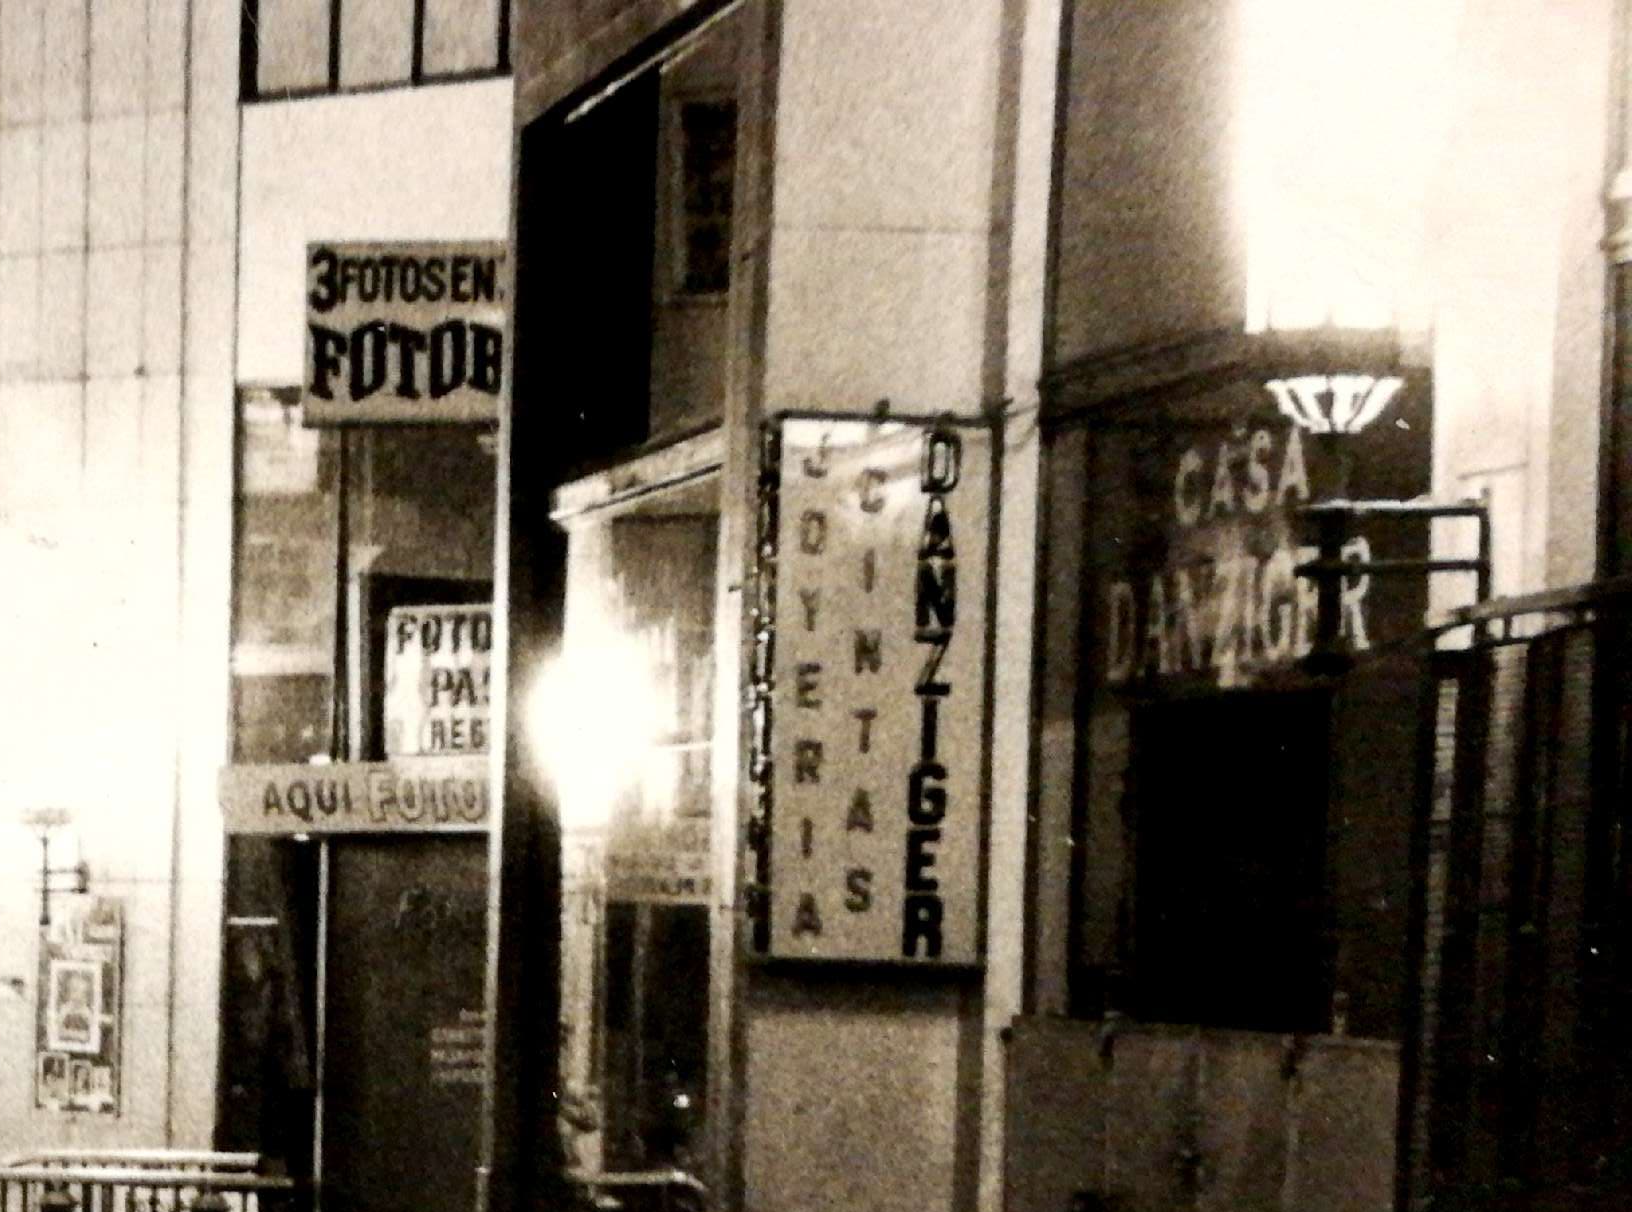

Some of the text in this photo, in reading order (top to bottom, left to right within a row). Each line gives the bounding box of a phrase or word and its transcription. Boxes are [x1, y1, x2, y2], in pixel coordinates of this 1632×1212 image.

[309, 245, 338, 313] 3
[340, 256, 446, 303] FOTOS
[451, 256, 495, 303] EN
[309, 318, 503, 402] FOTOB
[1174, 423, 1310, 526] CASA
[396, 613, 492, 655] FOTO
[1106, 536, 1371, 684] DANZIGER
[430, 666, 490, 707] PA
[791, 432, 831, 940] JOYERIA
[844, 468, 887, 914] CINTAS
[902, 428, 962, 958] DANZIGER
[263, 779, 353, 822] AQUI
